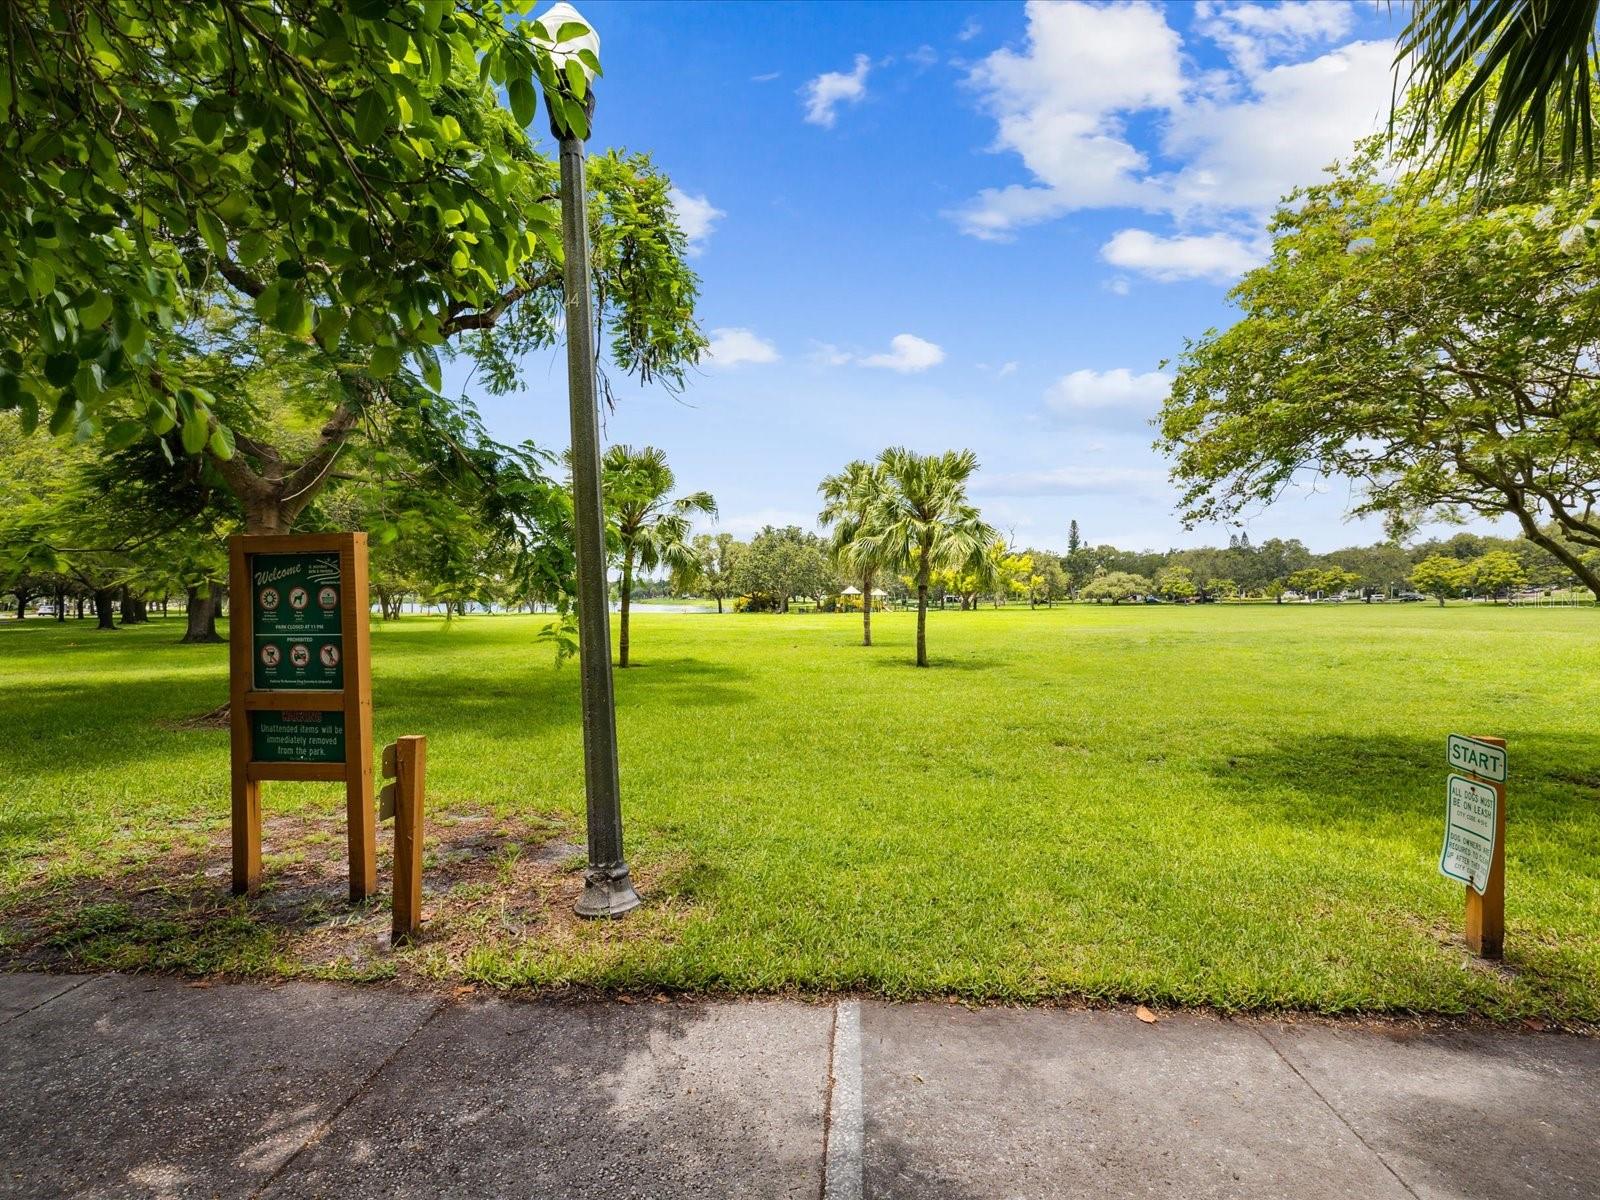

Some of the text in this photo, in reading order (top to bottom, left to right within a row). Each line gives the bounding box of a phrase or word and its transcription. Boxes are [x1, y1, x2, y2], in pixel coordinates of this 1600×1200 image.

[255, 564, 303, 586] Welcome
[260, 724, 343, 734] Unattended items will be
[266, 736, 337, 745] immediately removed
[278, 746, 293, 755] from
[295, 747, 307, 755] the
[1452, 743, 1500, 772] START
[1452, 786, 1493, 809] ALL DOGS MUST
[1453, 797, 1492, 819] BE ON LEASH
[1456, 810, 1465, 818] CITY
[1450, 832, 1461, 842] DOG
[1463, 837, 1482, 851] OWNERS
[1448, 842, 1471, 856] REQUIRED
[1472, 851, 1479, 860] TO
[1456, 855, 1470, 865] AFTER
